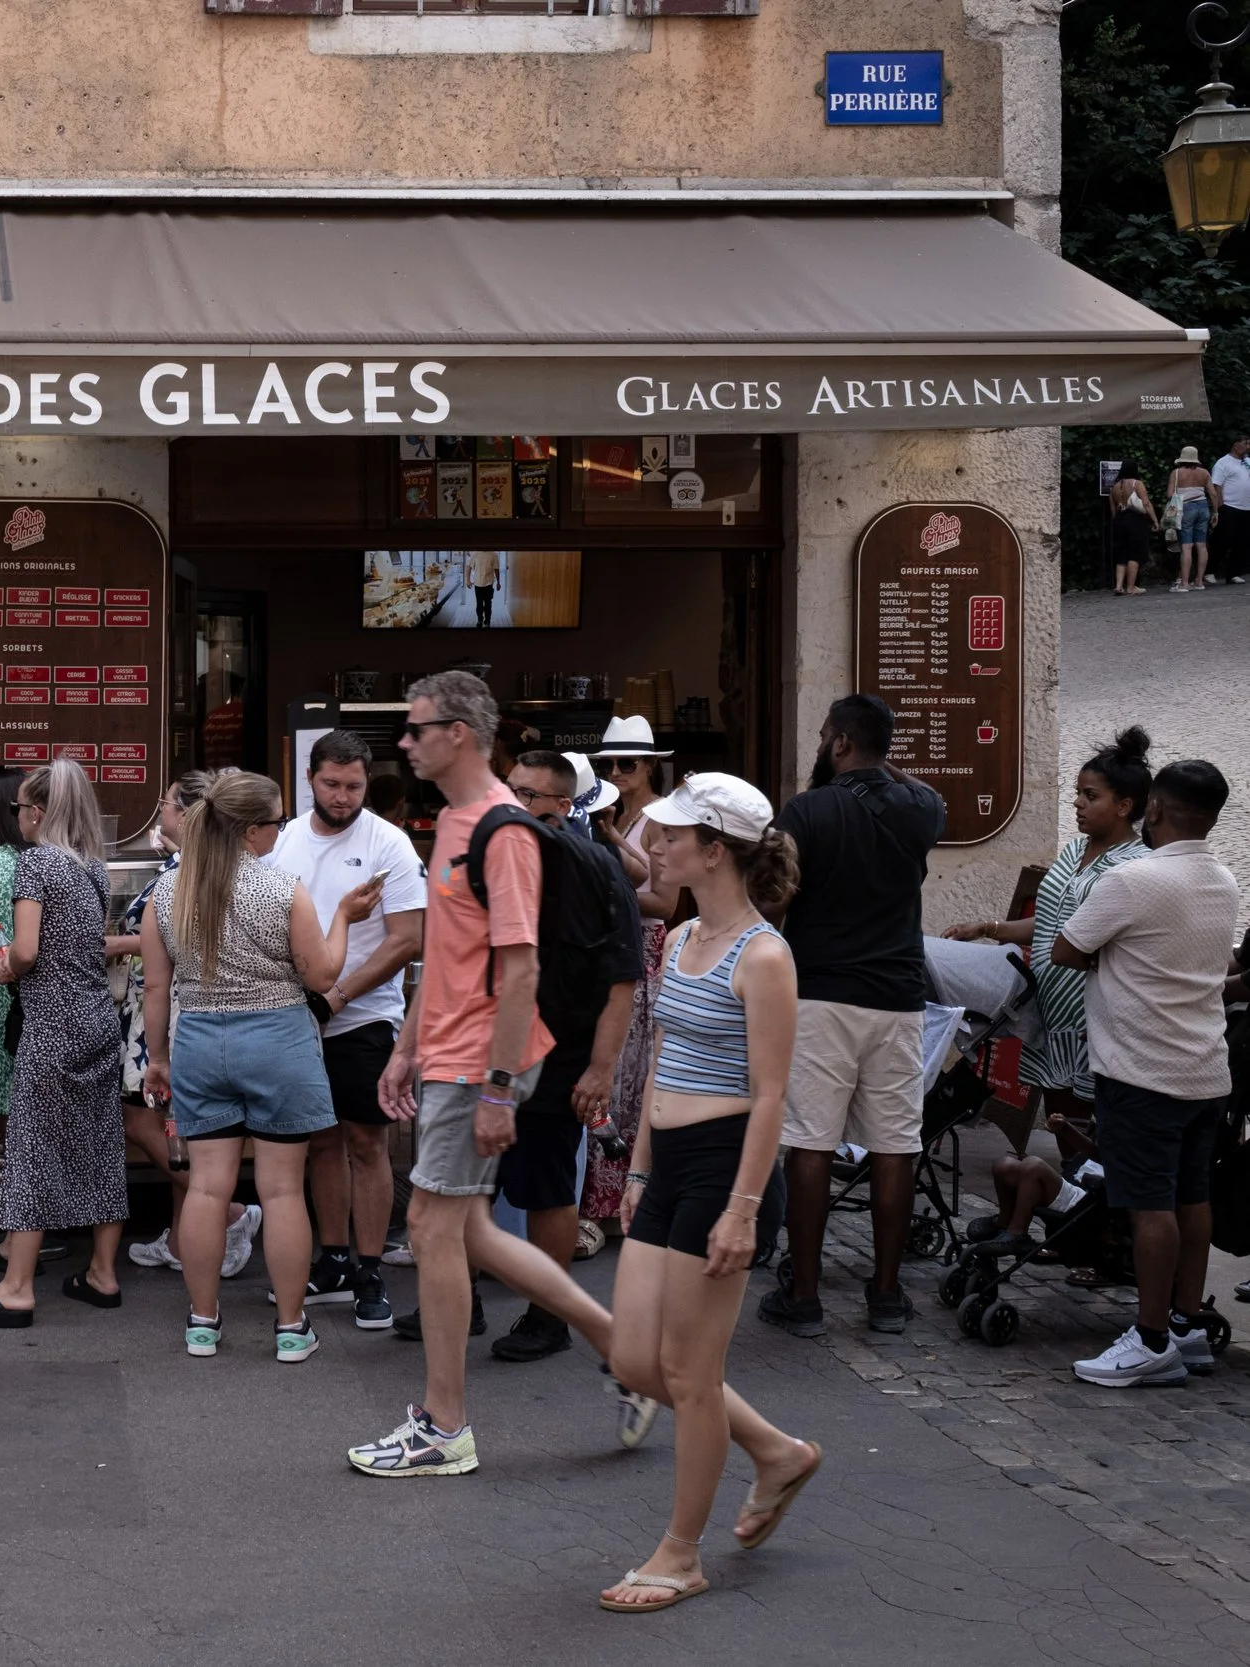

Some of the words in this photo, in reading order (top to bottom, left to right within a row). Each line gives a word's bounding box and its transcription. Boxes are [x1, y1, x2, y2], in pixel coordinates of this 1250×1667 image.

[863, 65, 907, 83] RUE
[830, 90, 938, 111] PERRIÈRE
[140, 362, 449, 426] GLACES
[617, 377, 782, 416] GLACES
[807, 376, 1104, 414] ARTISANALES
[405, 477, 430, 485] 2021
[441, 477, 468, 485] 2022
[480, 477, 507, 485] 2023
[520, 477, 547, 485] 2025
[24, 562, 76, 570] ORIGINALES
[62, 593, 92, 601] RÉGLISSE
[904, 620, 920, 629] SALÉ
[2, 644, 43, 652] SORBETS
[554, 733, 602, 746] BOISSON
